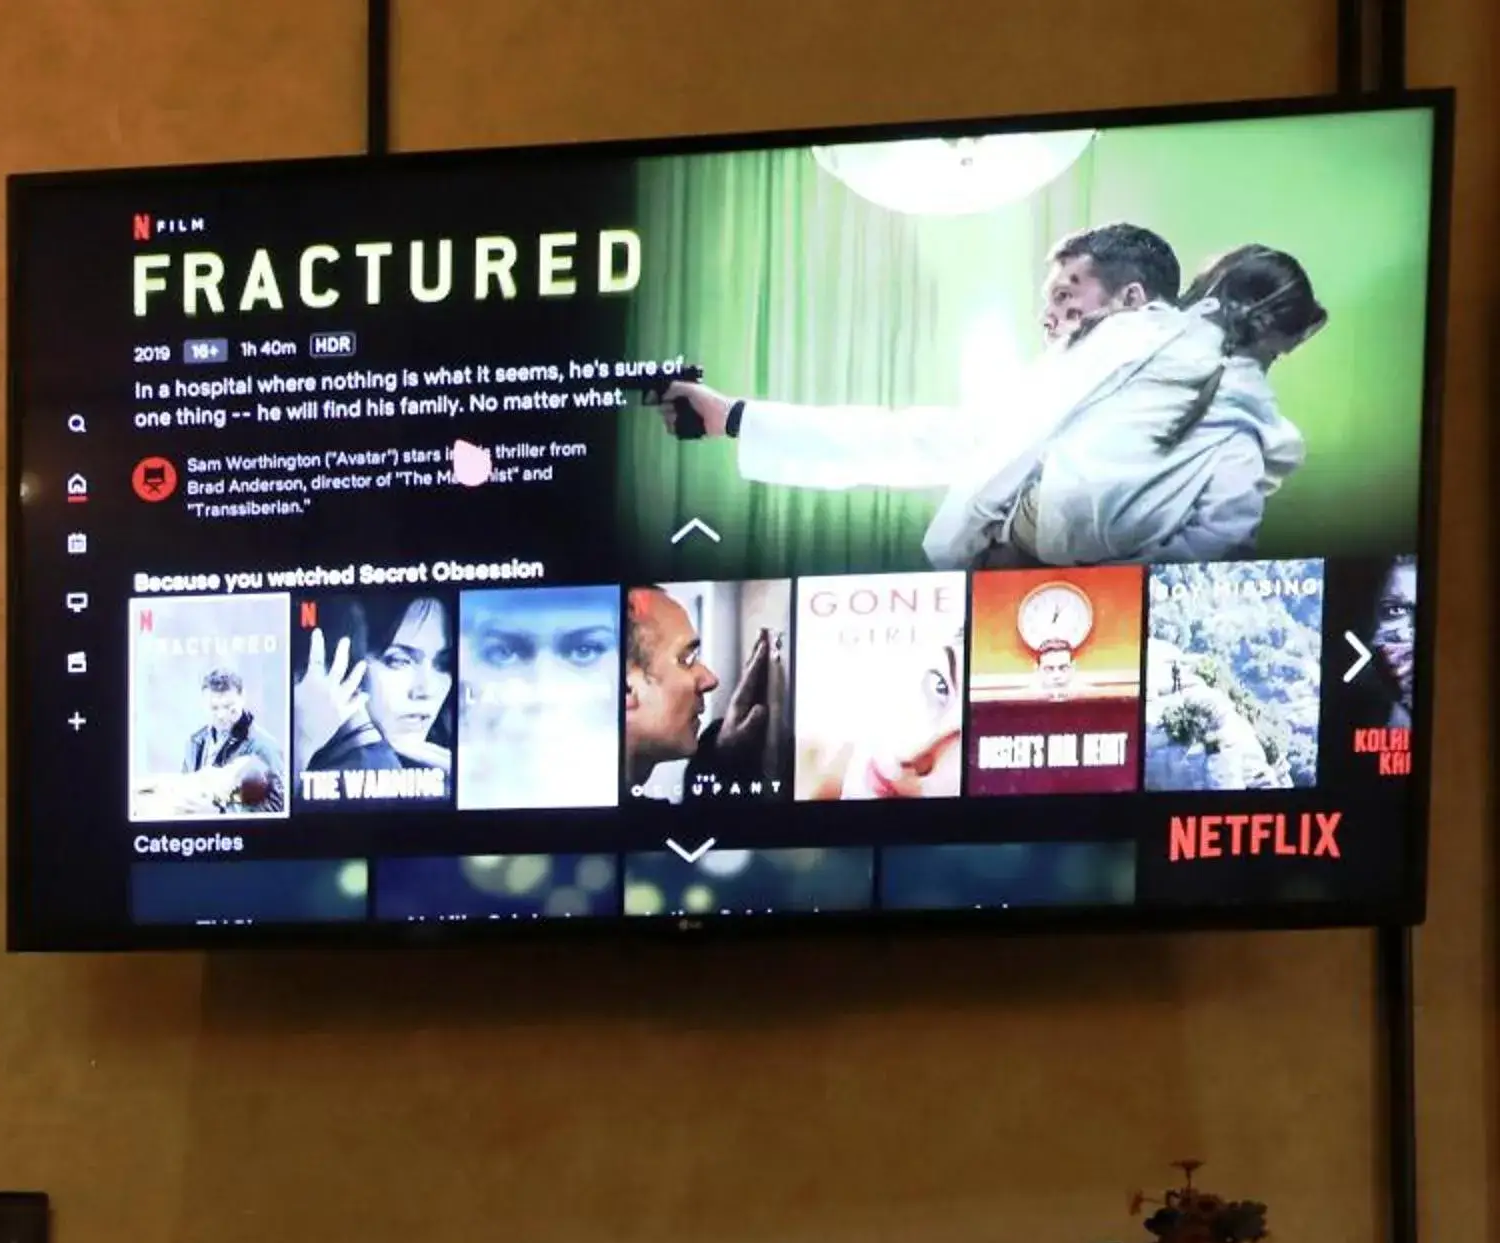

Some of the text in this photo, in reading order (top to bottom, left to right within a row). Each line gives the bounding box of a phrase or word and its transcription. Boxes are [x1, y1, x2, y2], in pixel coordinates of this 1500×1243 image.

[156, 218, 205, 233] FILM
[134, 229, 642, 317] FRACTURED
[134, 346, 171, 361] 2019
[240, 341, 256, 357] 1h
[259, 340, 297, 357] 40m
[315, 336, 351, 353] HDR
[135, 355, 684, 400] In a hospital where nothing is what it seems, he's sure of
[135, 412, 171, 428] one
[176, 406, 227, 429] thing
[257, 404, 282, 422] he
[286, 401, 318, 421] will
[323, 399, 361, 419] find
[366, 398, 395, 417] his
[400, 394, 464, 417] family.
[470, 395, 498, 413] No
[503, 390, 569, 411] matter
[573, 387, 628, 407] what.
[187, 456, 221, 473] Sam
[225, 452, 321, 473] Worthington
[403, 447, 441, 464] stars
[495, 442, 545, 459] thriller
[550, 441, 587, 457] from
[187, 479, 224, 496] Brad
[228, 477, 307, 495] Anderson,
[311, 473, 371, 490] director
[376, 471, 392, 488] of
[396, 468, 432, 486] "The
[523, 466, 553, 483] and
[187, 499, 311, 518] "Transsiberian."
[134, 558, 544, 594] Because you watched Secret Obsession
[810, 587, 951, 617] GONE
[133, 832, 244, 856] Categories
[1169, 811, 1342, 863] NETFLIX
